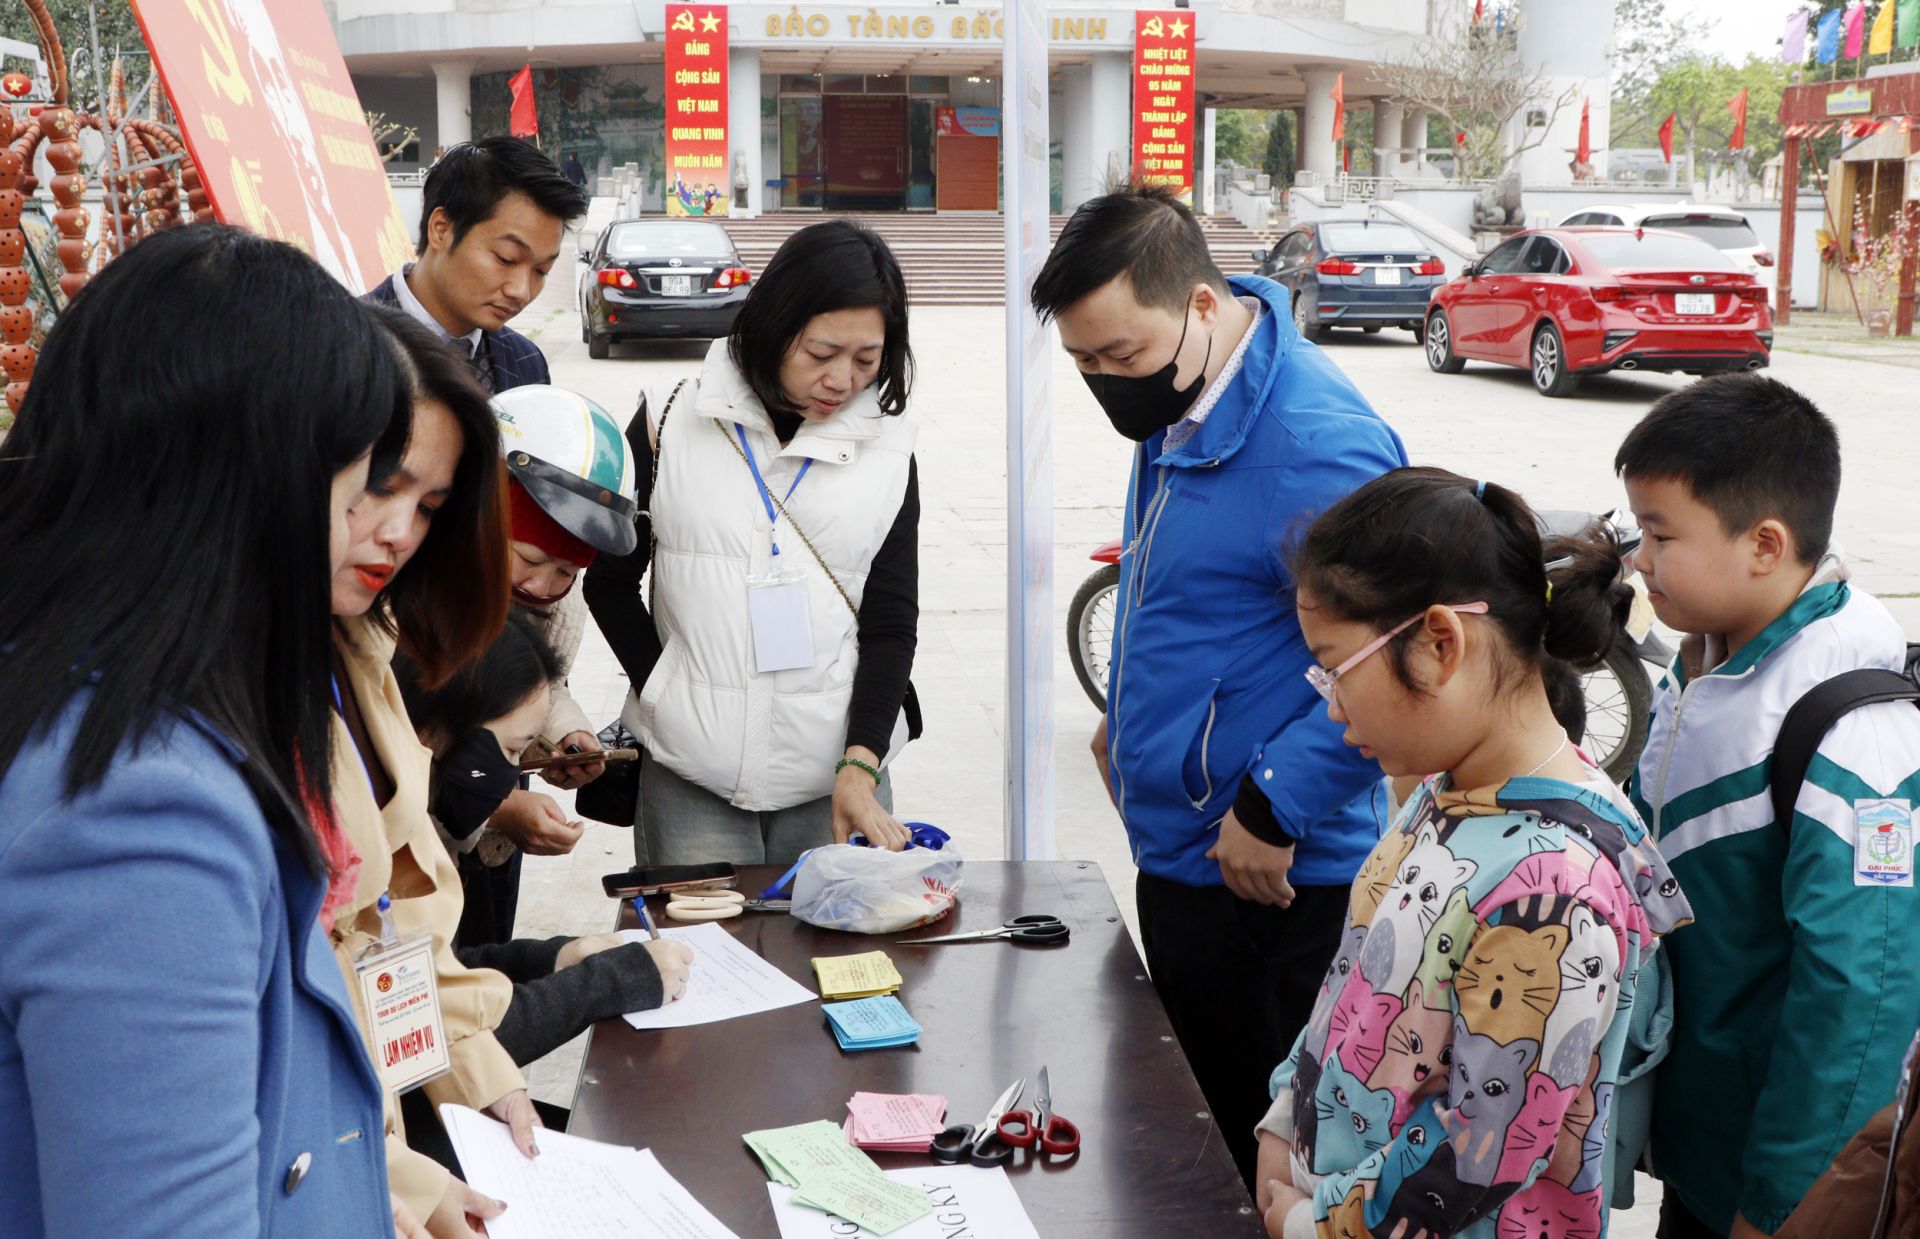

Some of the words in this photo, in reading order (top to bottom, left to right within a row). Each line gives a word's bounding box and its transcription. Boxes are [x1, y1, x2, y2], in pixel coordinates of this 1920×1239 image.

[766, 5, 831, 38] BẢO
[847, 8, 935, 38] TÀNG
[1051, 17, 1107, 41] INH
[685, 39, 710, 56] ĐẢNG
[1143, 48, 1168, 62] NHIỆT
[1170, 48, 1187, 62] LIỆT
[675, 69, 700, 87] CỘNG
[701, 67, 721, 84] SẢN
[1140, 63, 1163, 75] CHÀO
[1165, 63, 1190, 76] MỪNG
[1149, 80, 1159, 91] 95
[1161, 79, 1181, 91] NĂM
[677, 98, 697, 114] VIỆT
[697, 100, 719, 113] NAM
[1153, 94, 1176, 107] NGÀY
[1141, 110, 1169, 123] THÀNH
[1171, 110, 1188, 125] LẬP
[672, 128, 702, 141] QUANG
[703, 128, 725, 140] VINH
[1152, 125, 1176, 138] ĐẢNG
[1142, 142, 1166, 156] CỘNG
[1167, 141, 1185, 154] SẢN
[702, 154, 723, 169] NĂM
[1163, 159, 1184, 170] NAM
[383, 1037, 402, 1068] LÀM
[400, 1027, 424, 1062] NHIỆM
[424, 1024, 436, 1055] VỤ
